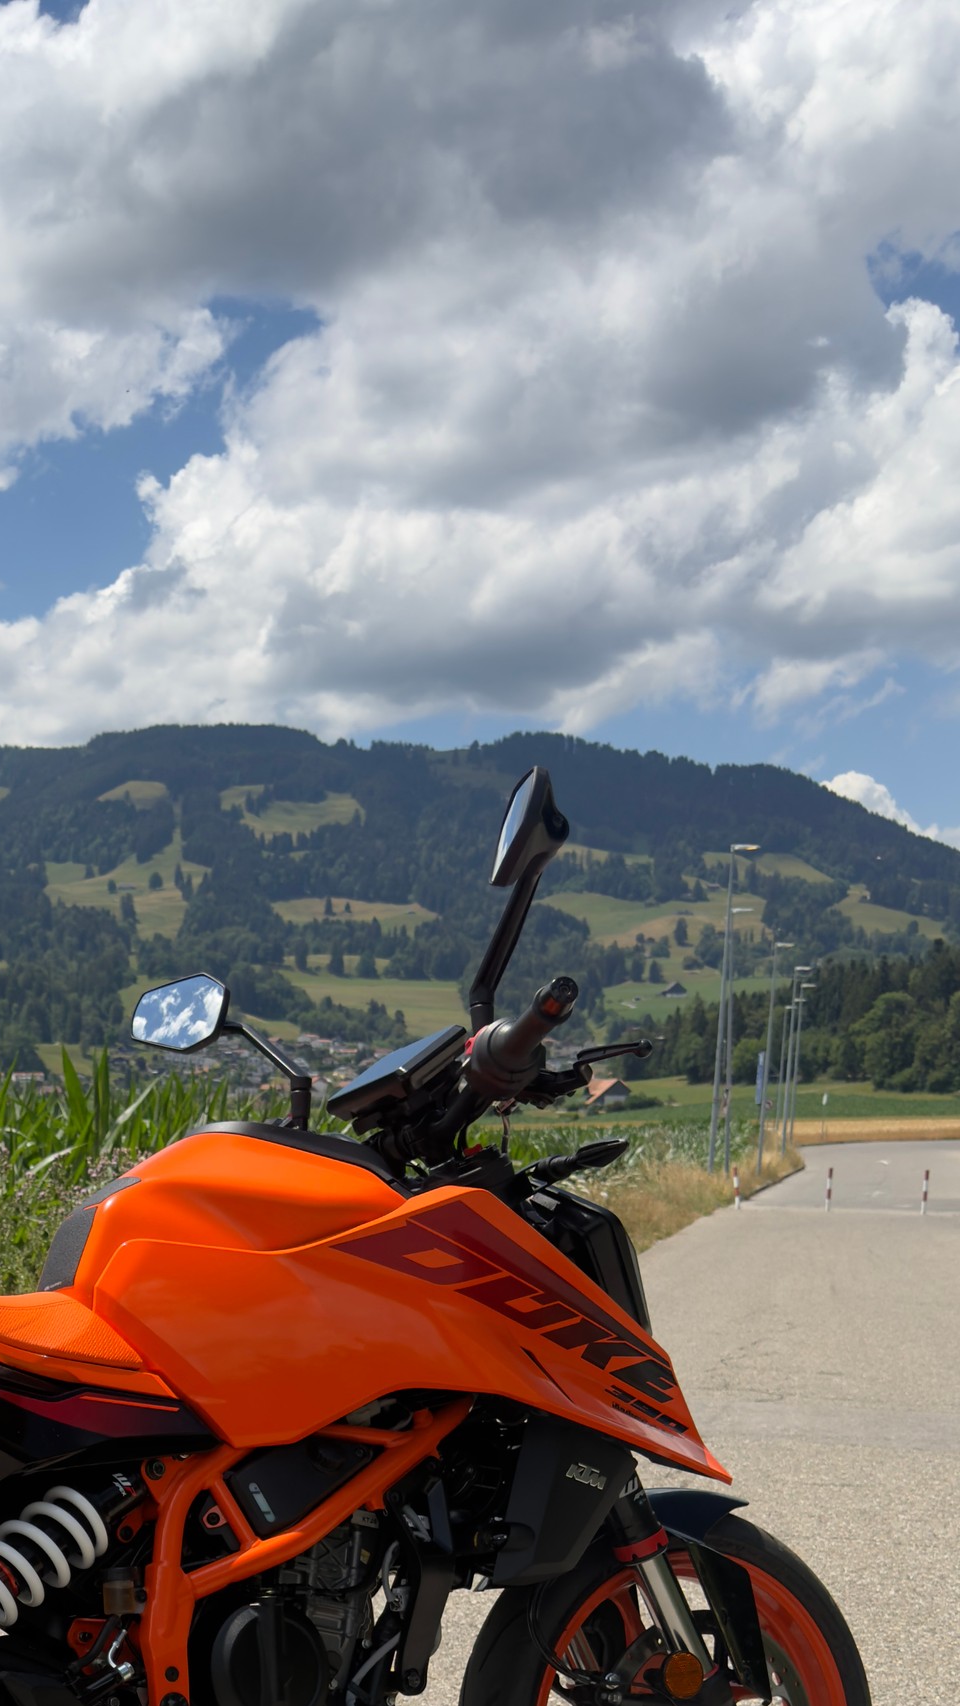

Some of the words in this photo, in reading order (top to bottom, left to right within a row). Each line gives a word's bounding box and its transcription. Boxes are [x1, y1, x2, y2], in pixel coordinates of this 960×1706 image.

[329, 1223, 677, 1403] DUKE
[604, 1384, 689, 1434] 390
[565, 1462, 608, 1491] KTM
